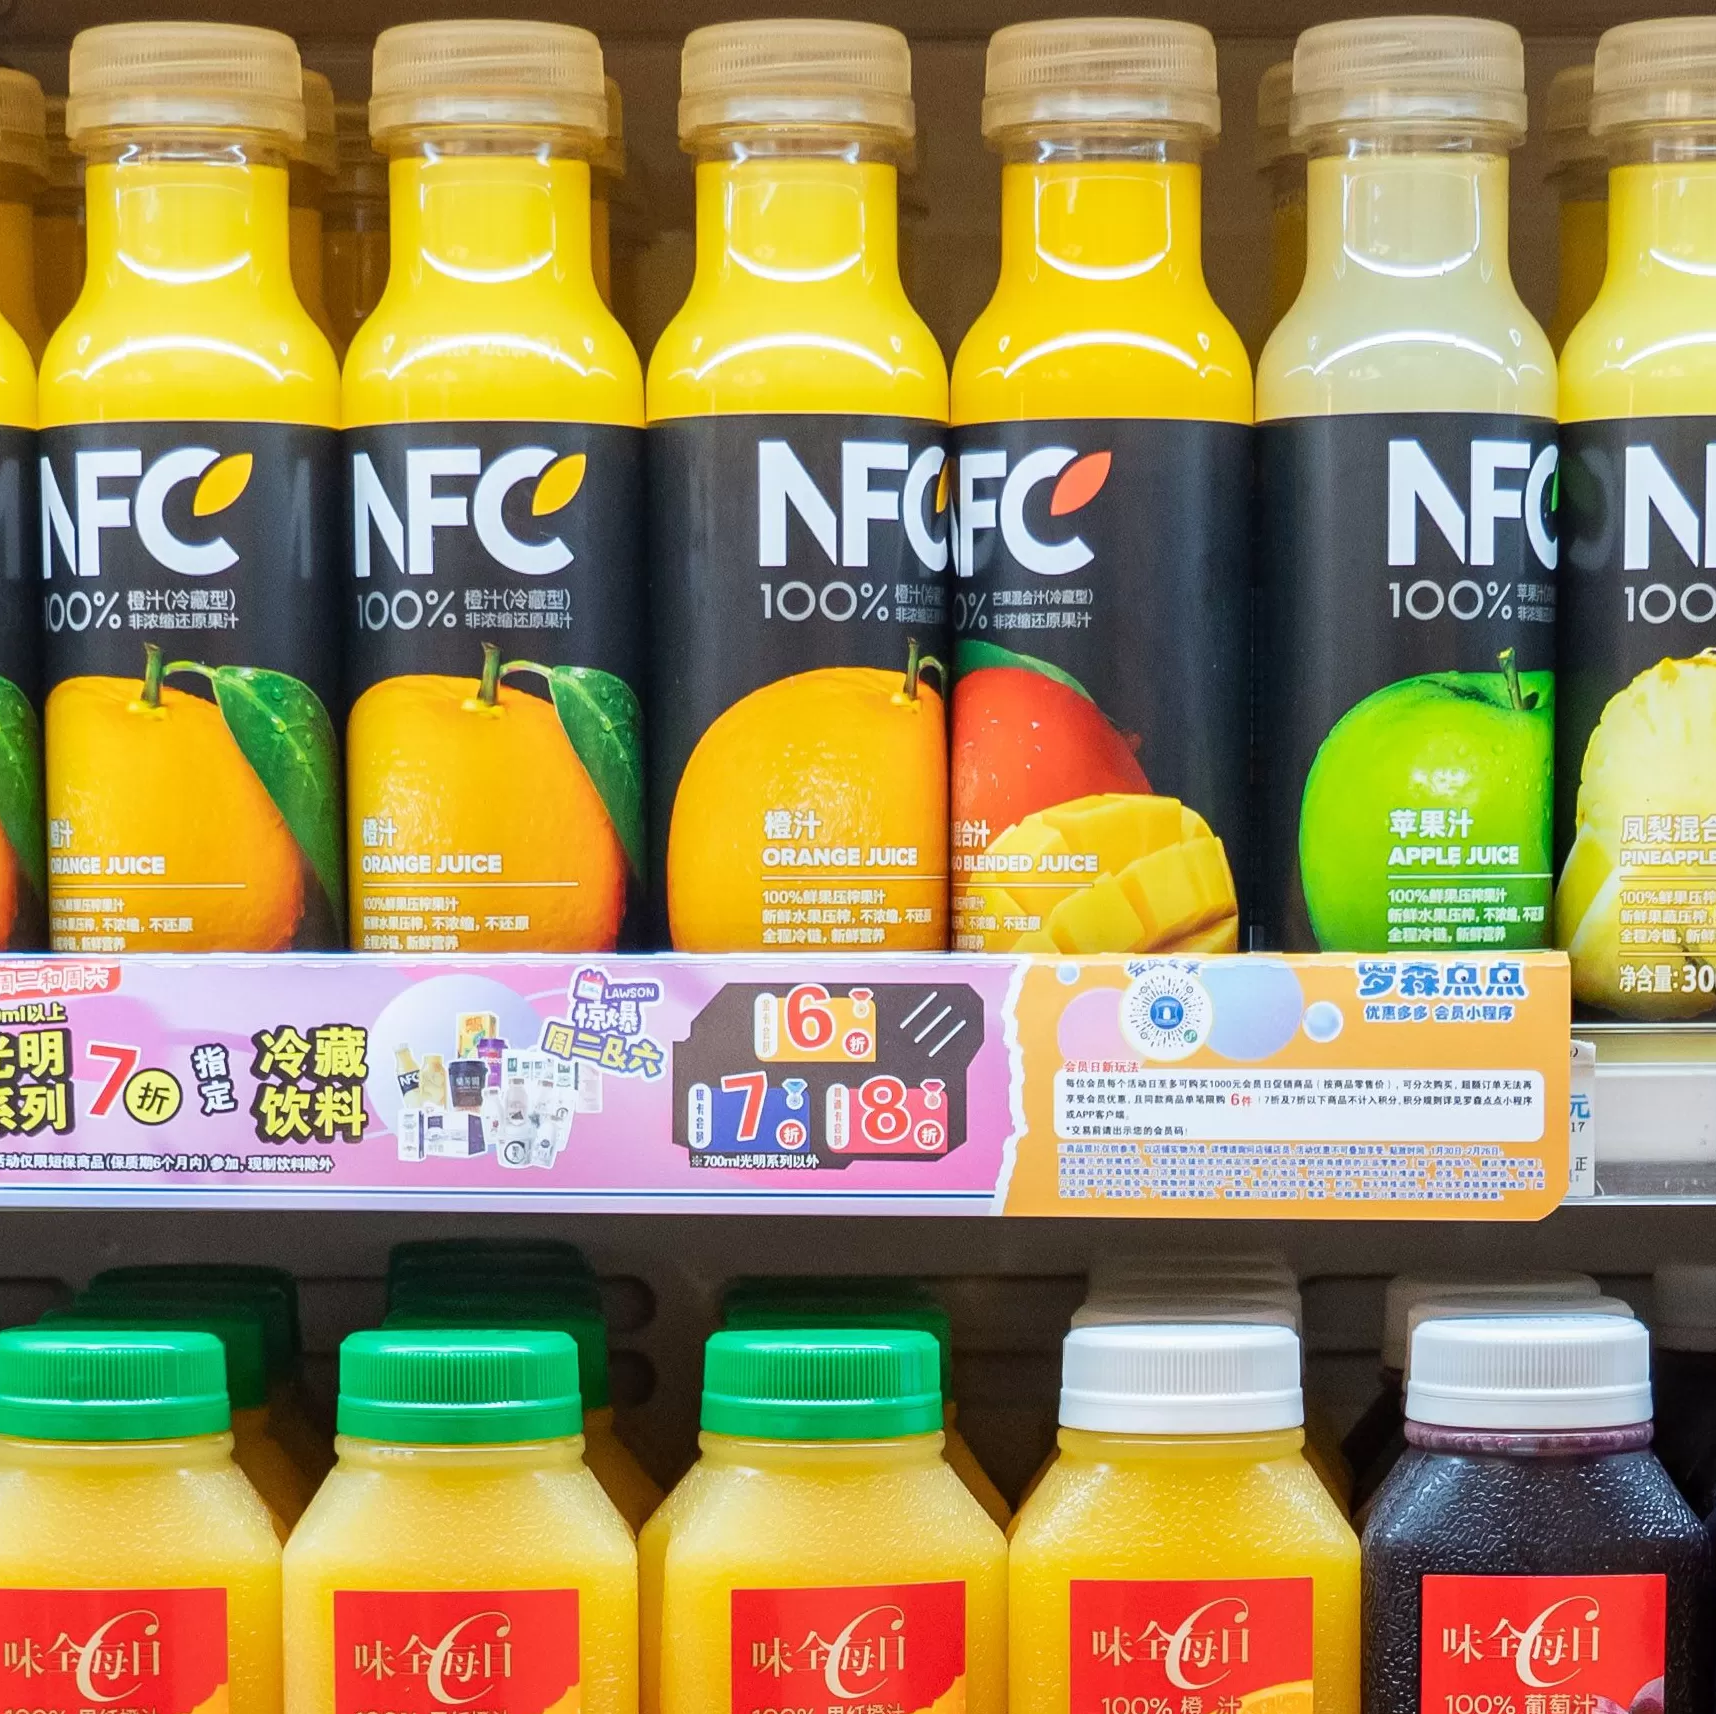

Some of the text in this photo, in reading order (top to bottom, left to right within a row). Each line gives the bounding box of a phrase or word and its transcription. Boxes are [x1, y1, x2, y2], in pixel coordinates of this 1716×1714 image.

[42, 448, 239, 578] NFC
[1389, 580, 1511, 621] 100%
[465, 612, 572, 630] 非浓缩还原果汁
[993, 612, 1091, 630] 非浓缩还原果汁
[1389, 810, 1473, 838] 苹果汁
[363, 854, 502, 874] ORANGE JUICE
[763, 848, 917, 866] ORANGE JUICE
[1388, 847, 1519, 865] APPLE JUICE
[1357, 962, 1526, 999] 罗森点点
[604, 985, 654, 1001] LAWSON
[1365, 1005, 1514, 1022] 优惠多多 会员小程序
[259, 1027, 369, 1081] 冷藏
[259, 1086, 369, 1140] 饮料
